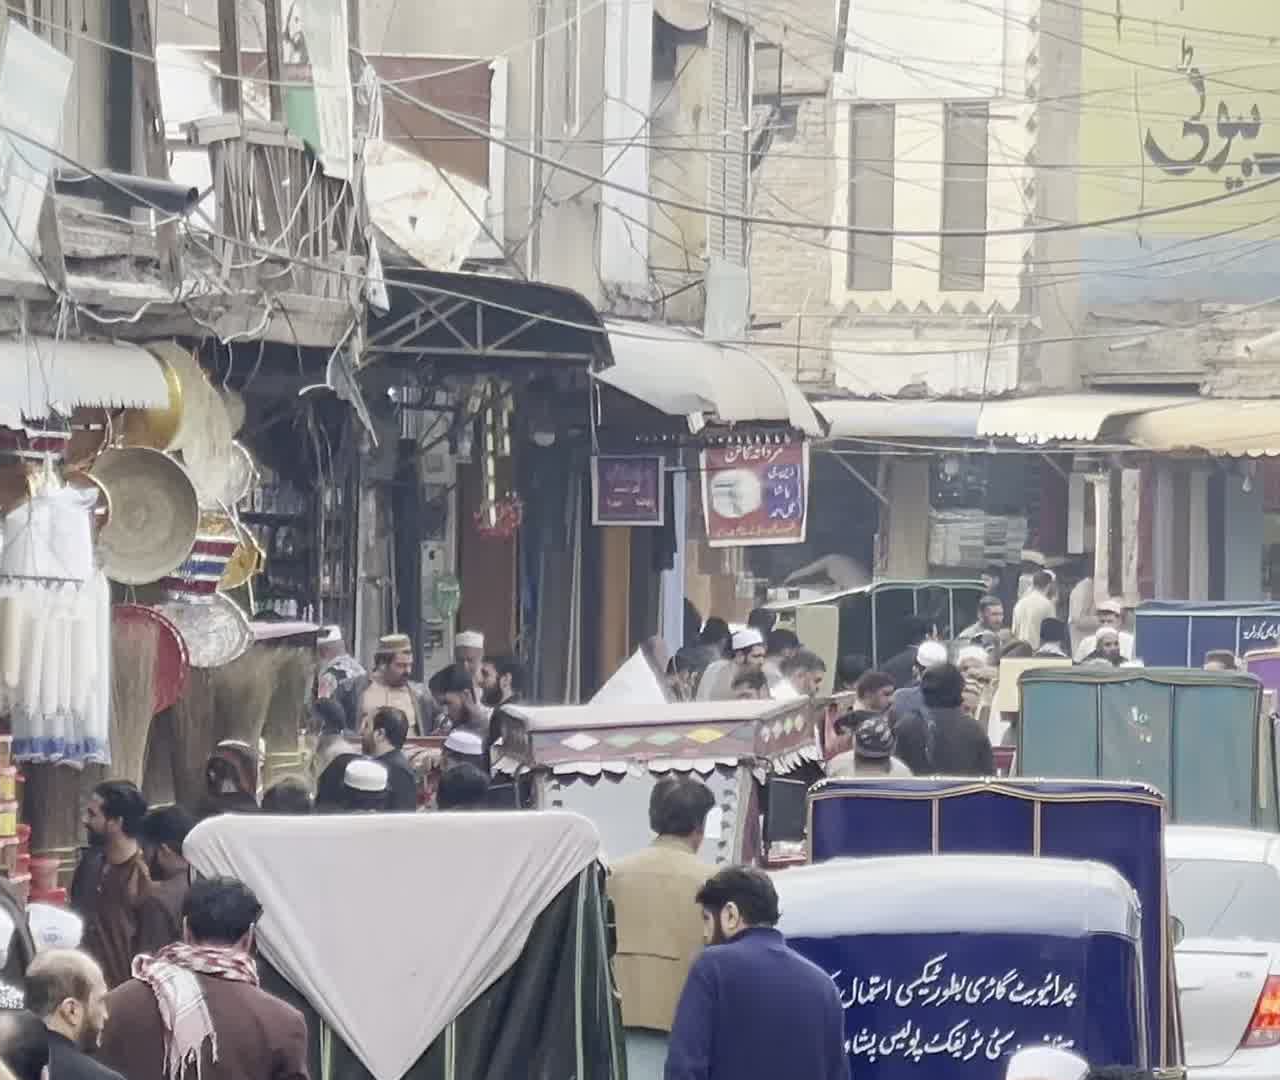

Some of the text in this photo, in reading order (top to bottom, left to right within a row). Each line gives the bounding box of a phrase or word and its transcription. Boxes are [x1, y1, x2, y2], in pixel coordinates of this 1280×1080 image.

[895, 952, 948, 1007] ٹیکسی
[921, 972, 967, 1007] بطور
[965, 968, 1018, 1004] گاڑی
[879, 1019, 923, 1063] پولیس
[986, 1027, 1016, 1060] سٹی
